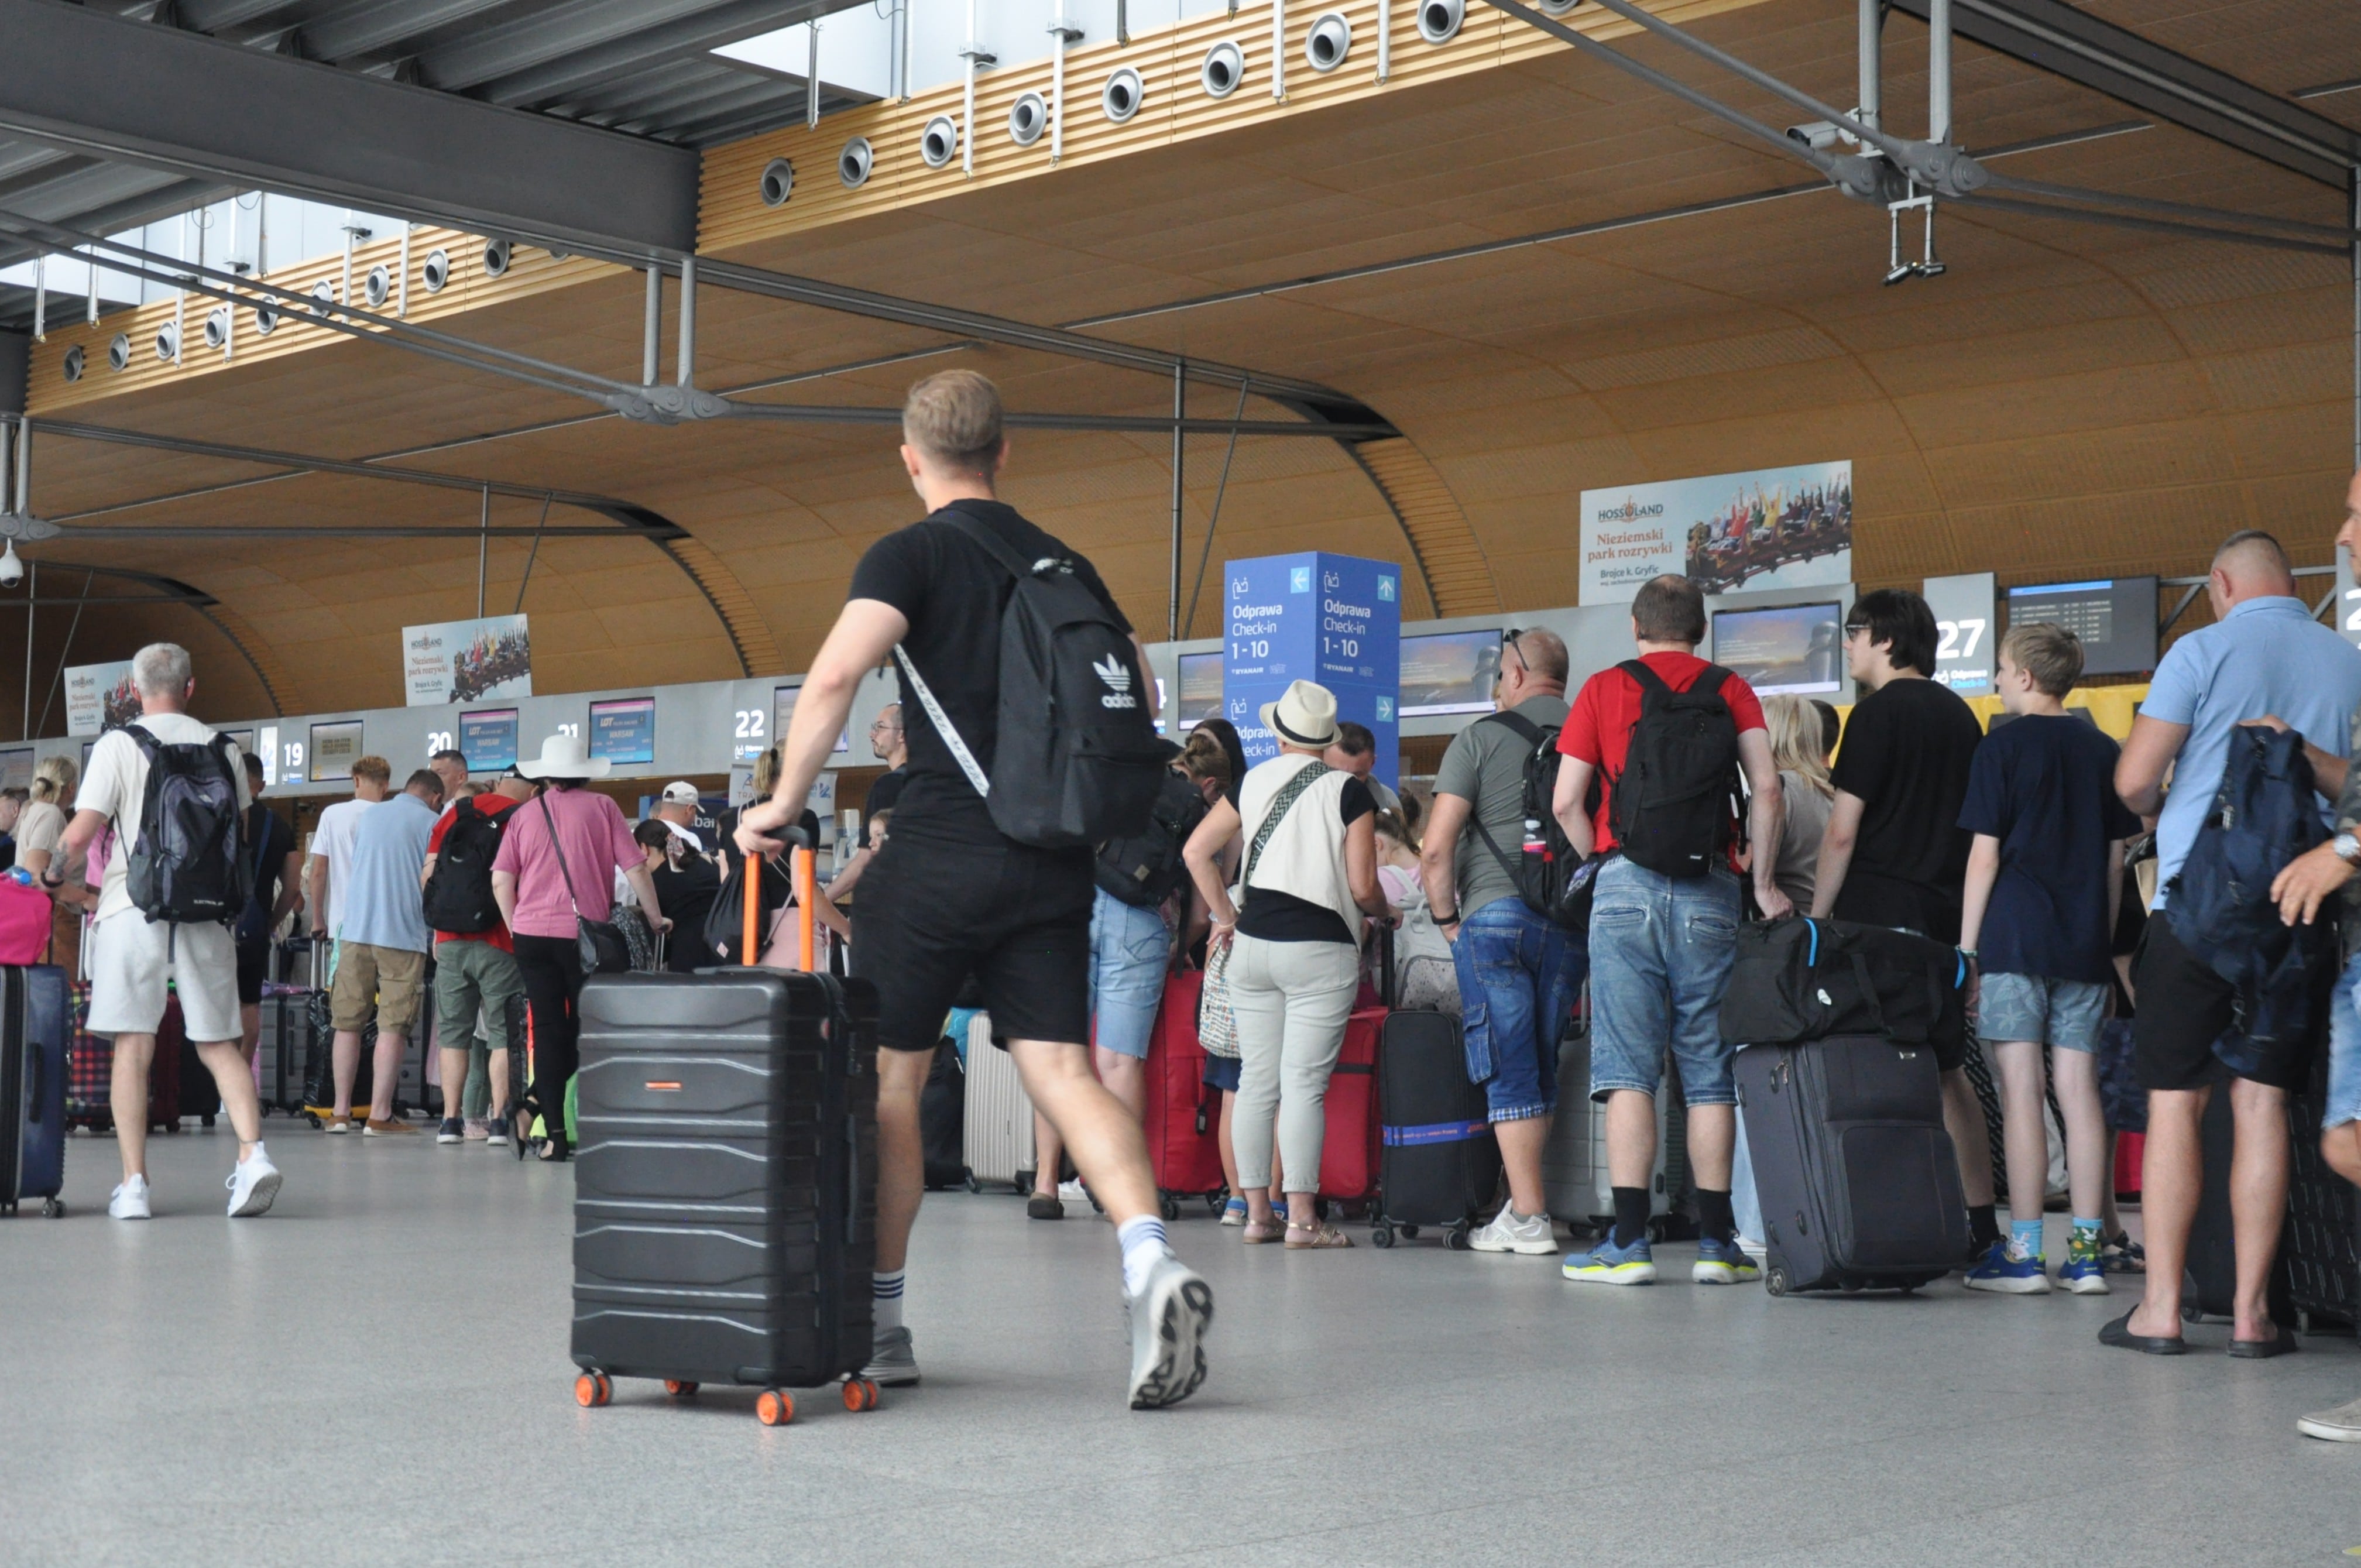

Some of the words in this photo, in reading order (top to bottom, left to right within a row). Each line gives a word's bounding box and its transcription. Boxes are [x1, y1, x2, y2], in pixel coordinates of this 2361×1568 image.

[1598, 504, 1663, 520] HOSSOLAND
[1597, 528, 1663, 545] Nieziemski
[1588, 547, 1615, 563] park
[1618, 542, 1672, 559] rozrywki
[1601, 568, 1625, 579] Brojce
[1233, 604, 1282, 620] Odprawa
[1324, 599, 1371, 617] Odprawa
[1232, 620, 1276, 636] Check-in
[1324, 617, 1365, 635] Check-in
[1323, 637, 1329, 654] 1
[1341, 639, 1358, 657] 10
[1936, 619, 1985, 659] 27
[1232, 643, 1238, 660] 1
[1250, 640, 1269, 658] 10
[1235, 667, 1264, 675] RYANAIR
[1326, 663, 1354, 673] RYANAIR
[1950, 670, 1988, 680] Odprawa
[1951, 679, 1987, 689] Check-in
[600, 718, 613, 727] LOT
[736, 709, 764, 738] 22
[469, 726, 481, 736] LOT
[609, 730, 634, 738] WARSAW
[1235, 726, 1275, 742] dpraw
[428, 732, 451, 757] 20
[477, 738, 500, 747] WARSAW
[284, 742, 303, 767] 19
